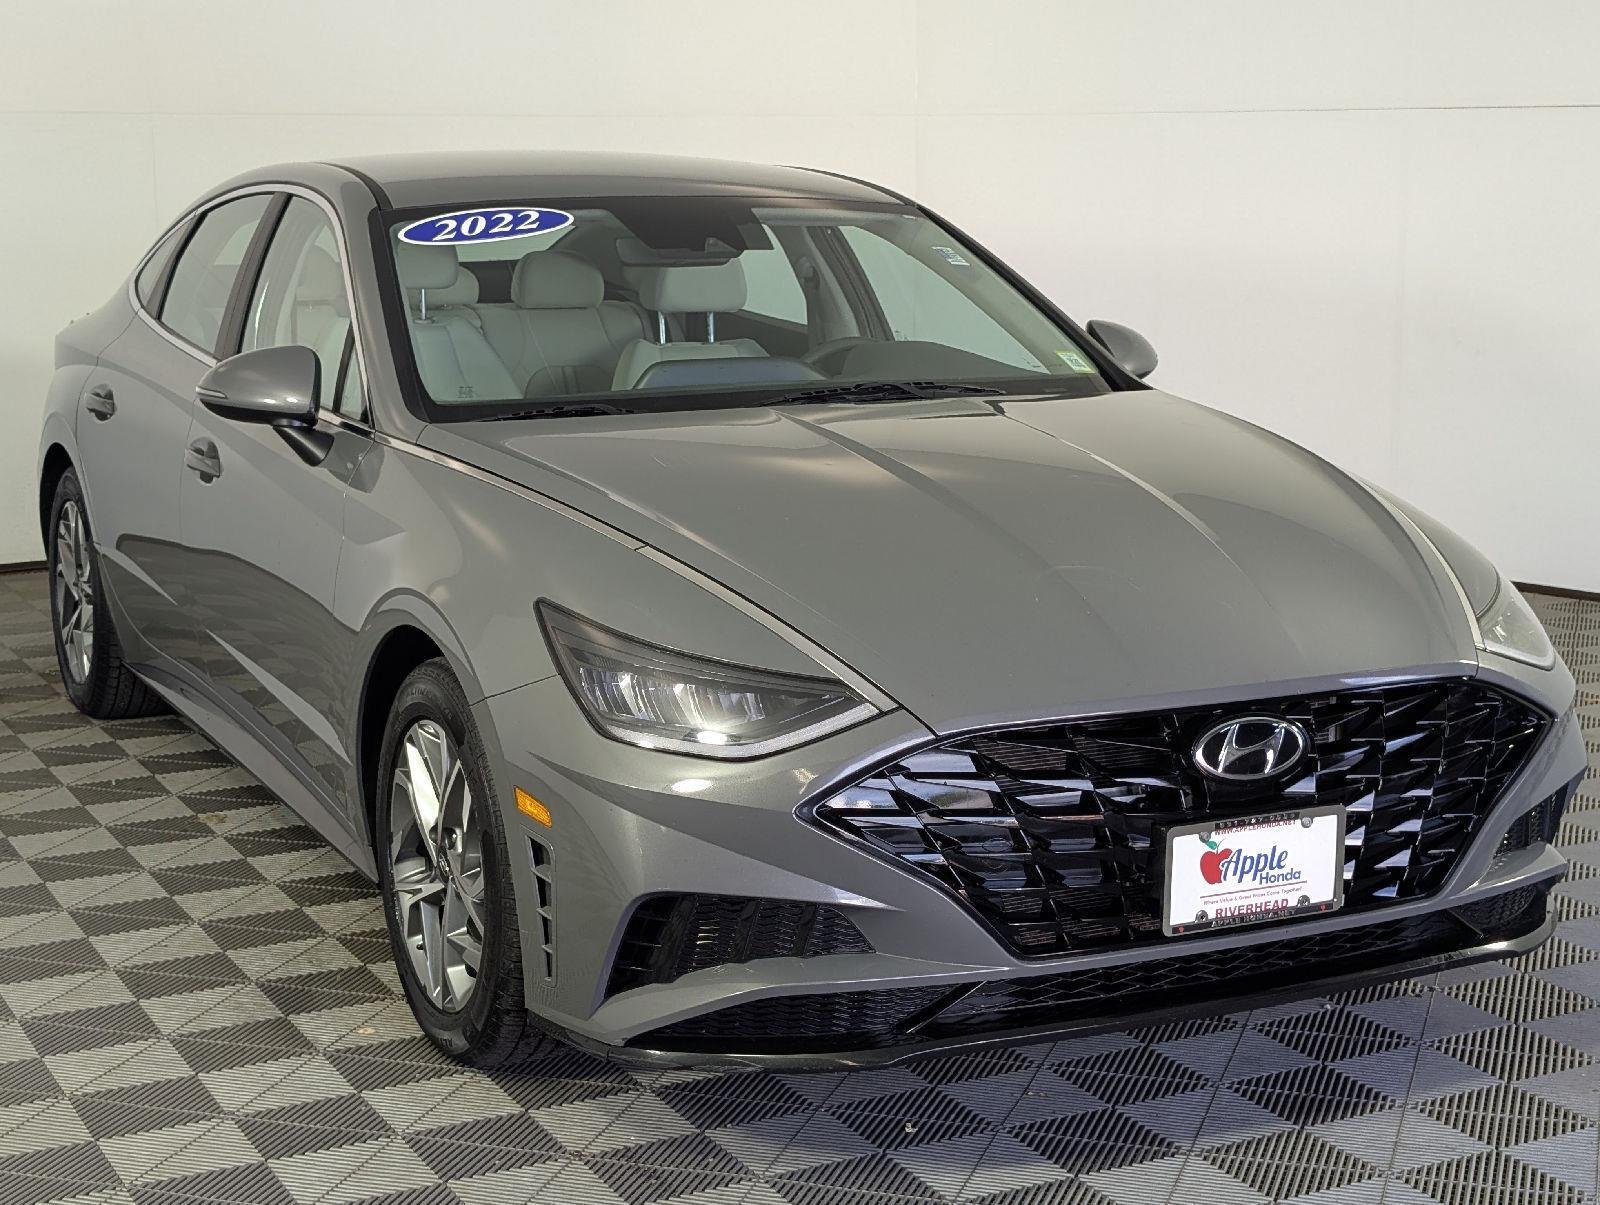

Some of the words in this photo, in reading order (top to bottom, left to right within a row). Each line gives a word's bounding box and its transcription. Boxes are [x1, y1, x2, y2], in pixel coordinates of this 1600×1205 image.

[432, 210, 540, 241] 2022
[1221, 845, 1288, 883] Apple
[1259, 868, 1301, 885] Honda
[1215, 898, 1289, 919] RIVERHEAD
